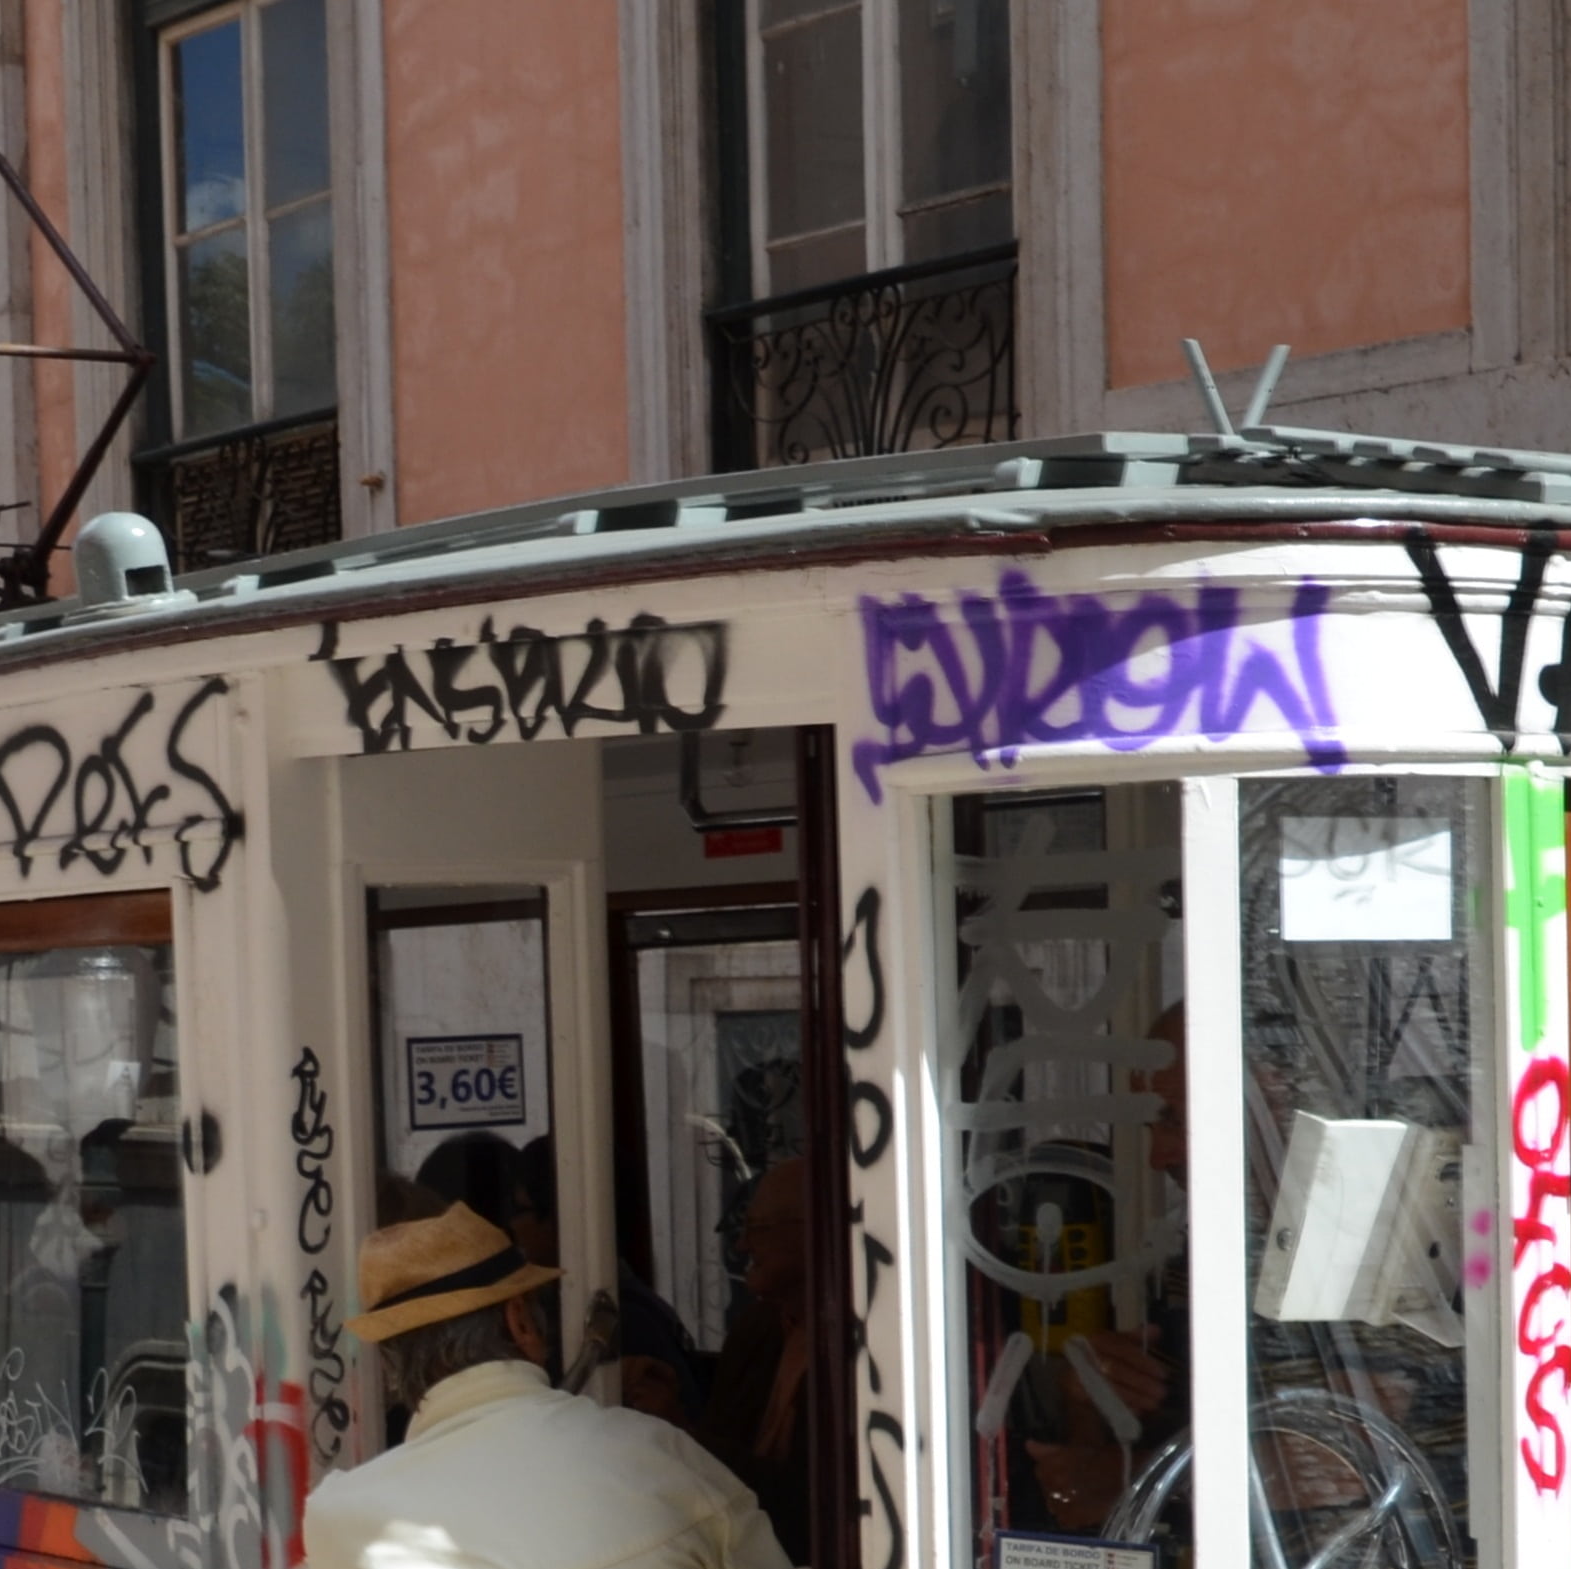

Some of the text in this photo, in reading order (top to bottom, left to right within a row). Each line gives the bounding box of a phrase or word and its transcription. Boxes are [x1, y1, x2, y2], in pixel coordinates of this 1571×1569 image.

[417, 1066, 518, 1109] 3,60€
[1005, 1541, 1100, 1560] TARIFA DE BORDO
[1005, 1555, 1021, 1566] ON
[1023, 1558, 1060, 1569] BOARD
